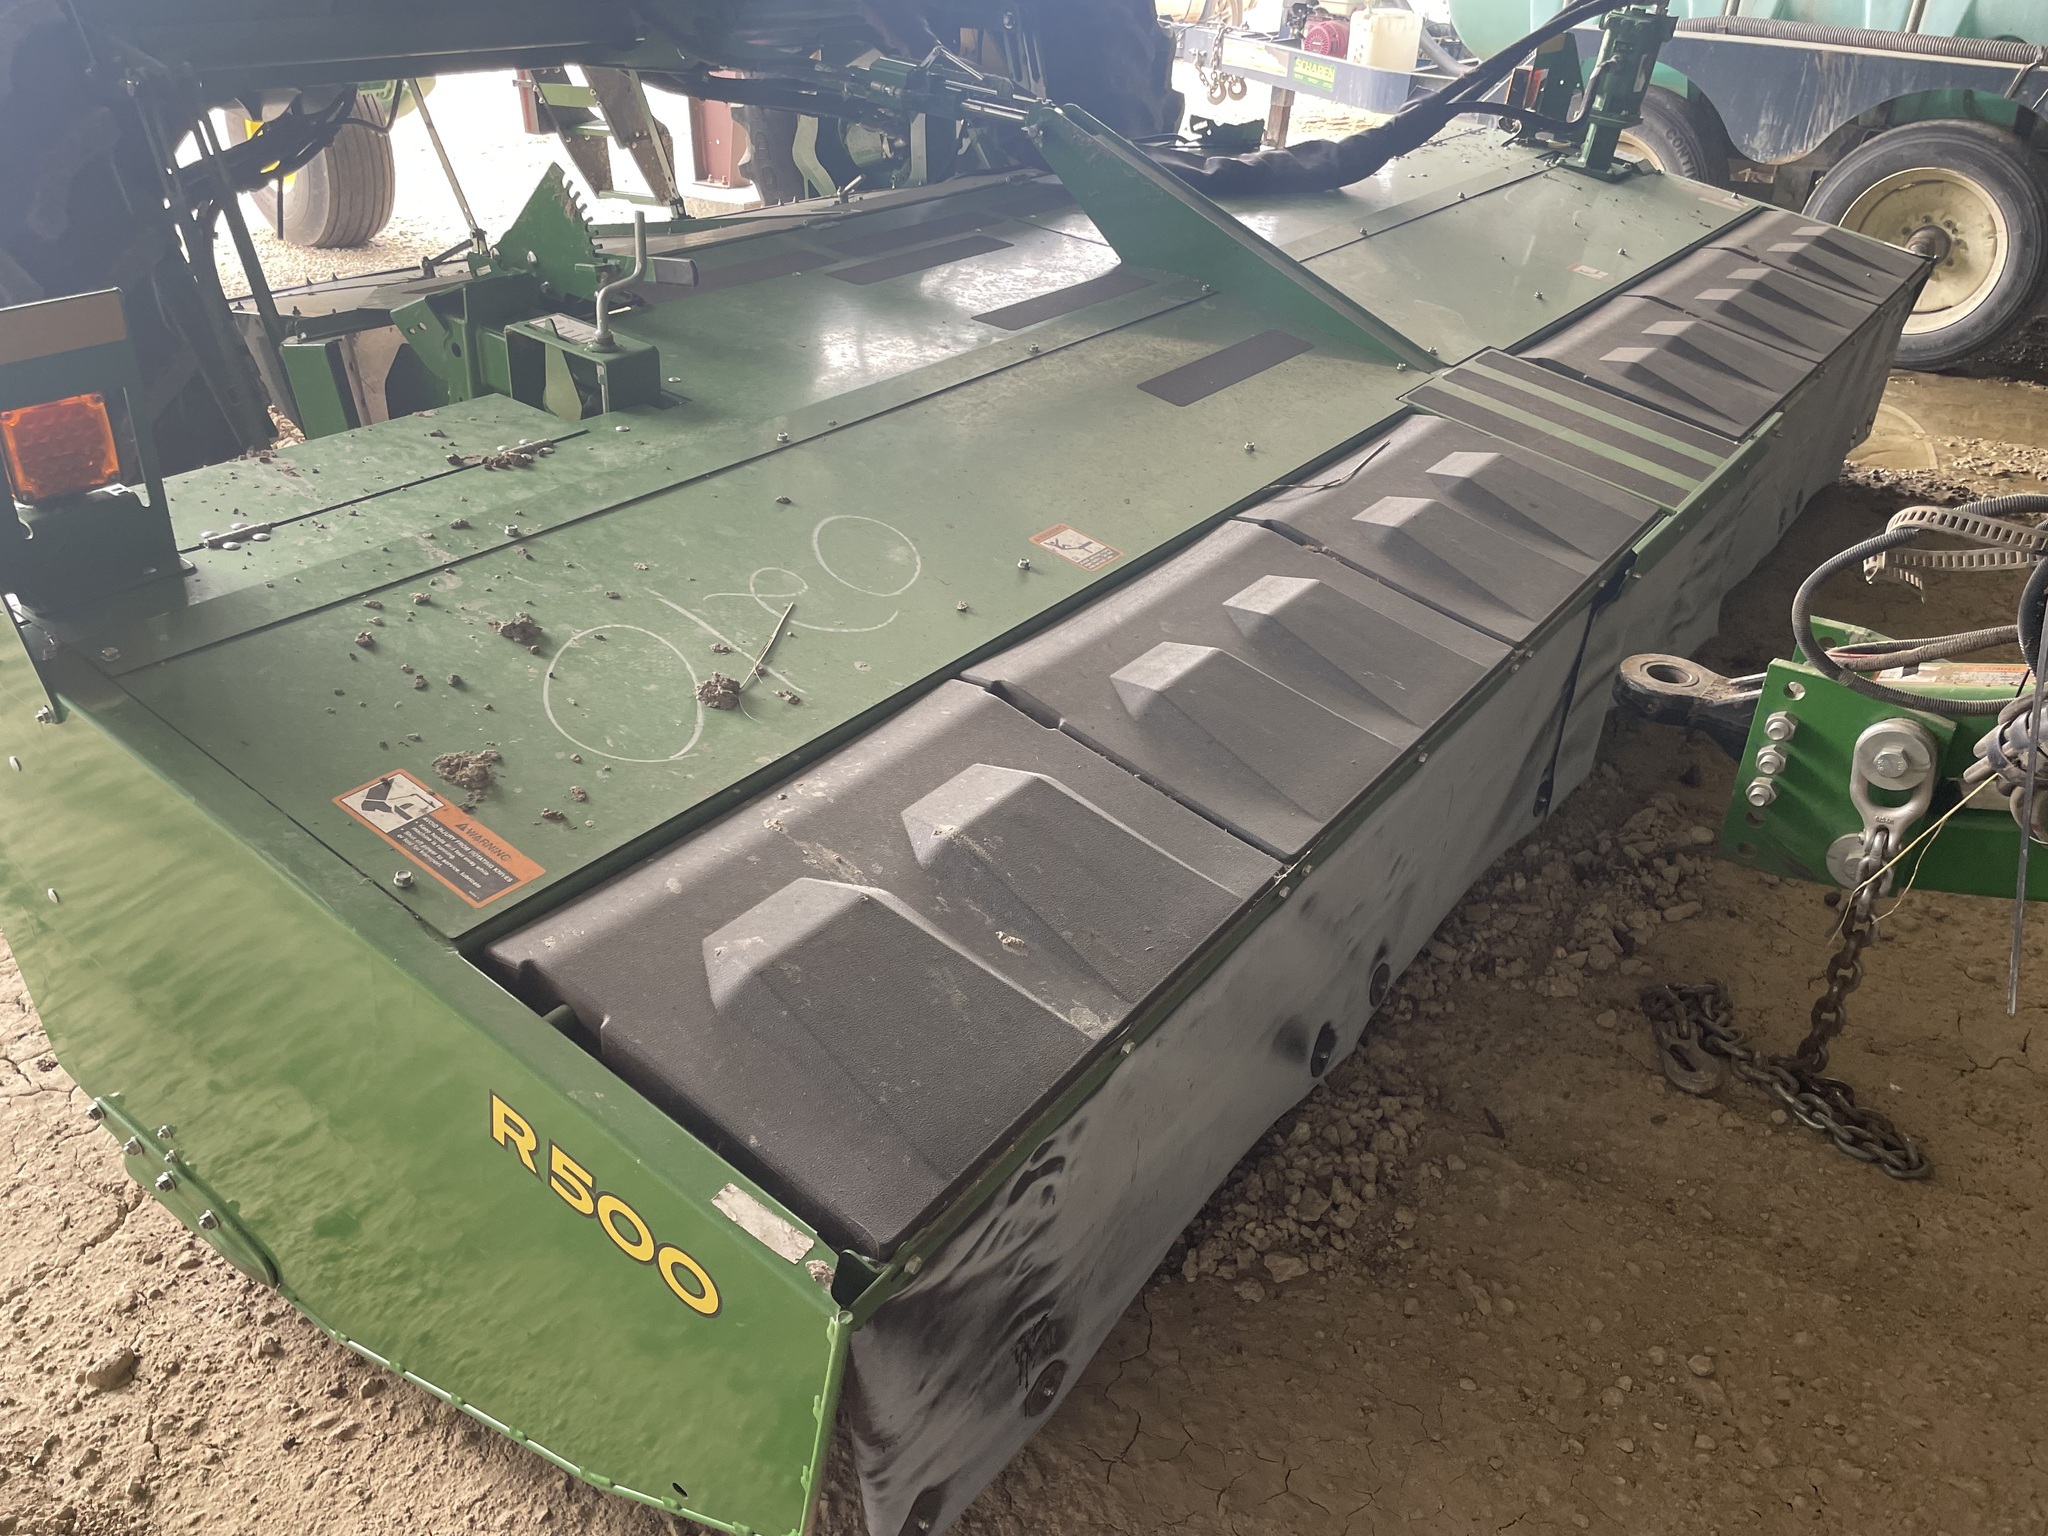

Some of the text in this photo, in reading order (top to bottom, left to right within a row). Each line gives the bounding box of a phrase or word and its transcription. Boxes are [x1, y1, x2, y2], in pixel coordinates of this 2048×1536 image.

[1294, 58, 1335, 83] SCHABEN
[411, 826, 432, 842] machine
[418, 823, 432, 834] Keep
[430, 832, 446, 845] hands
[475, 865, 489, 876] while
[422, 816, 439, 829] AVOID
[436, 826, 457, 841] INJURY
[454, 839, 471, 851] FROM
[468, 850, 495, 869] ROTATING
[466, 827, 511, 862] WARNING
[403, 830, 417, 841] Shut
[420, 844, 438, 856] power
[459, 872, 481, 889] lubricate
